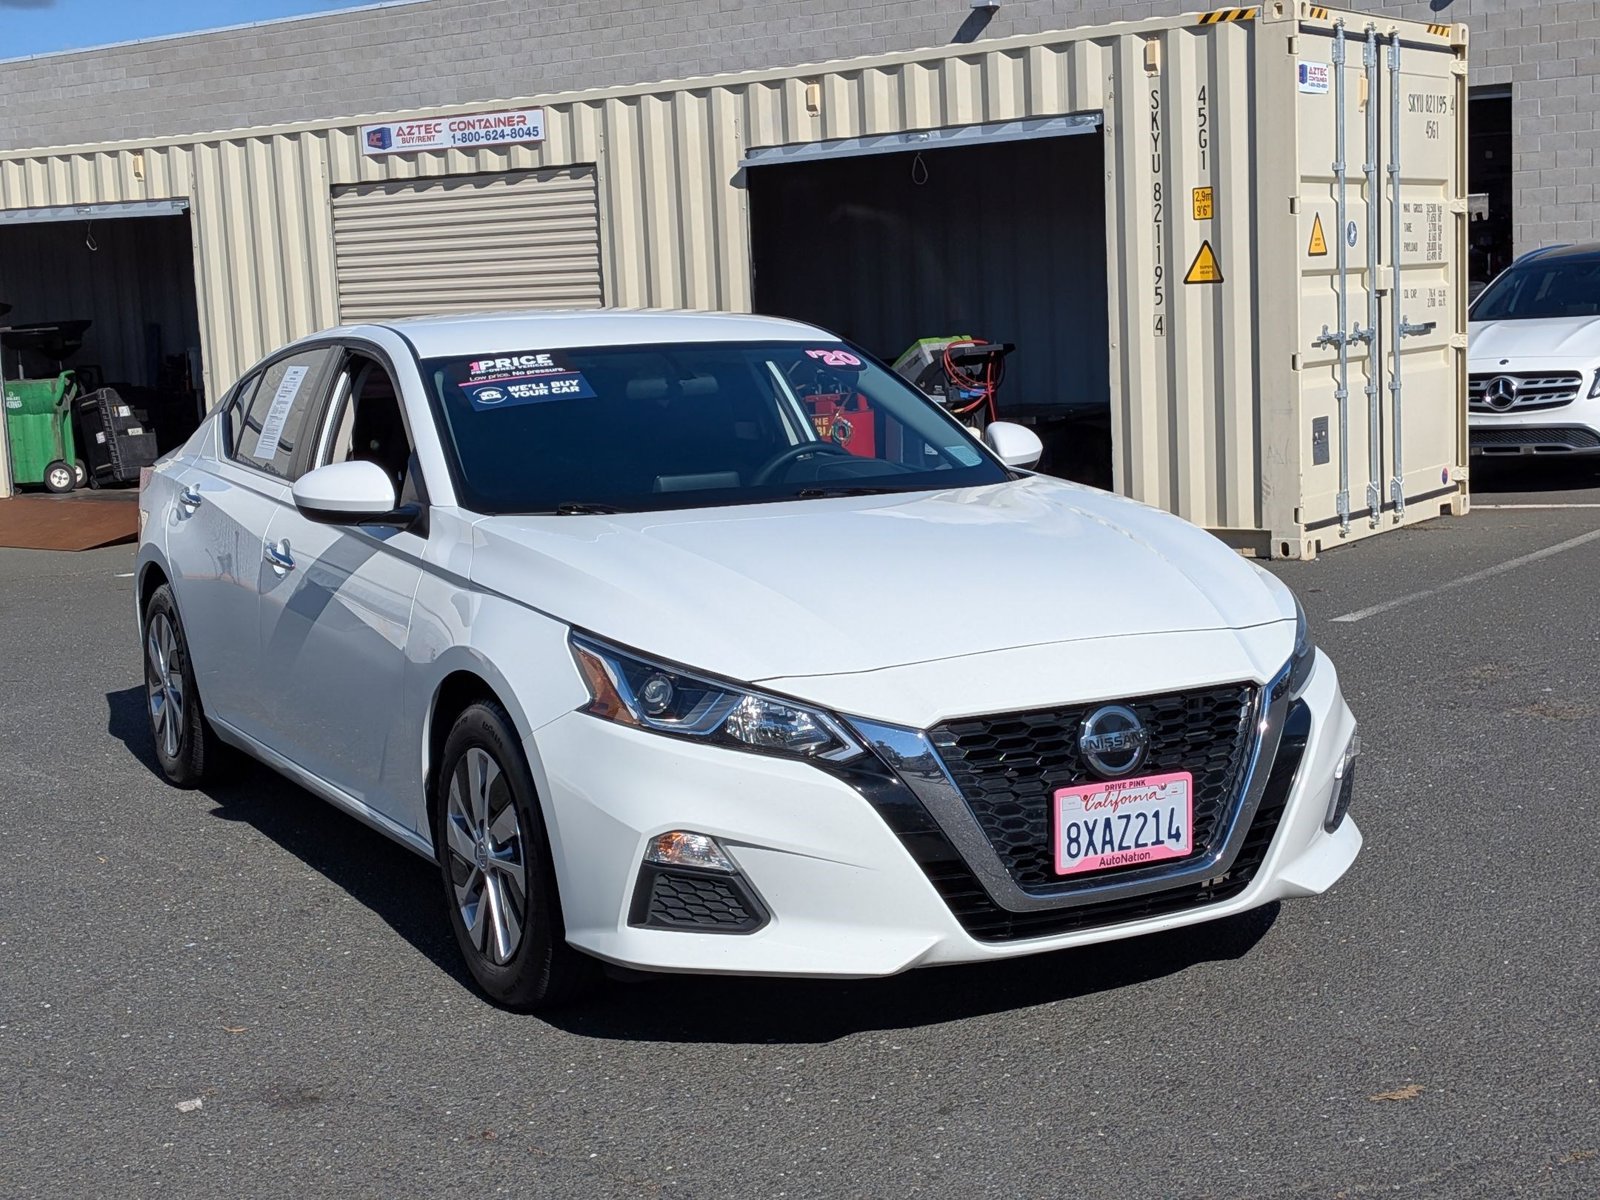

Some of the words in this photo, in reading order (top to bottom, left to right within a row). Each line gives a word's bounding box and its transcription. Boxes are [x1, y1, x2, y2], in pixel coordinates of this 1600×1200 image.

[1309, 66, 1327, 76] AZTEC
[1408, 93, 1424, 112] SKYU
[1425, 94, 1447, 114] 821195
[396, 122, 443, 137] AZTEC
[448, 114, 527, 132] CONTAINER
[1150, 89, 1161, 174] SKYU
[401, 135, 436, 144] BUY/RENT
[451, 126, 539, 145] 1-800-624-8045
[471, 365, 517, 375] PRE-OWNED
[488, 372, 511, 380] price.
[526, 367, 566, 375] pressure.
[507, 382, 548, 393] WE'LL
[511, 389, 549, 398] YOUR
[551, 386, 580, 394] CAR
[1089, 732, 1143, 750] NISSAN
[1104, 782, 1127, 791] DRIVE
[1129, 780, 1146, 788] PINK
[1084, 790, 1166, 813] California
[1066, 807, 1181, 859] 8XAZ214
[1099, 851, 1150, 867] AutoNation
